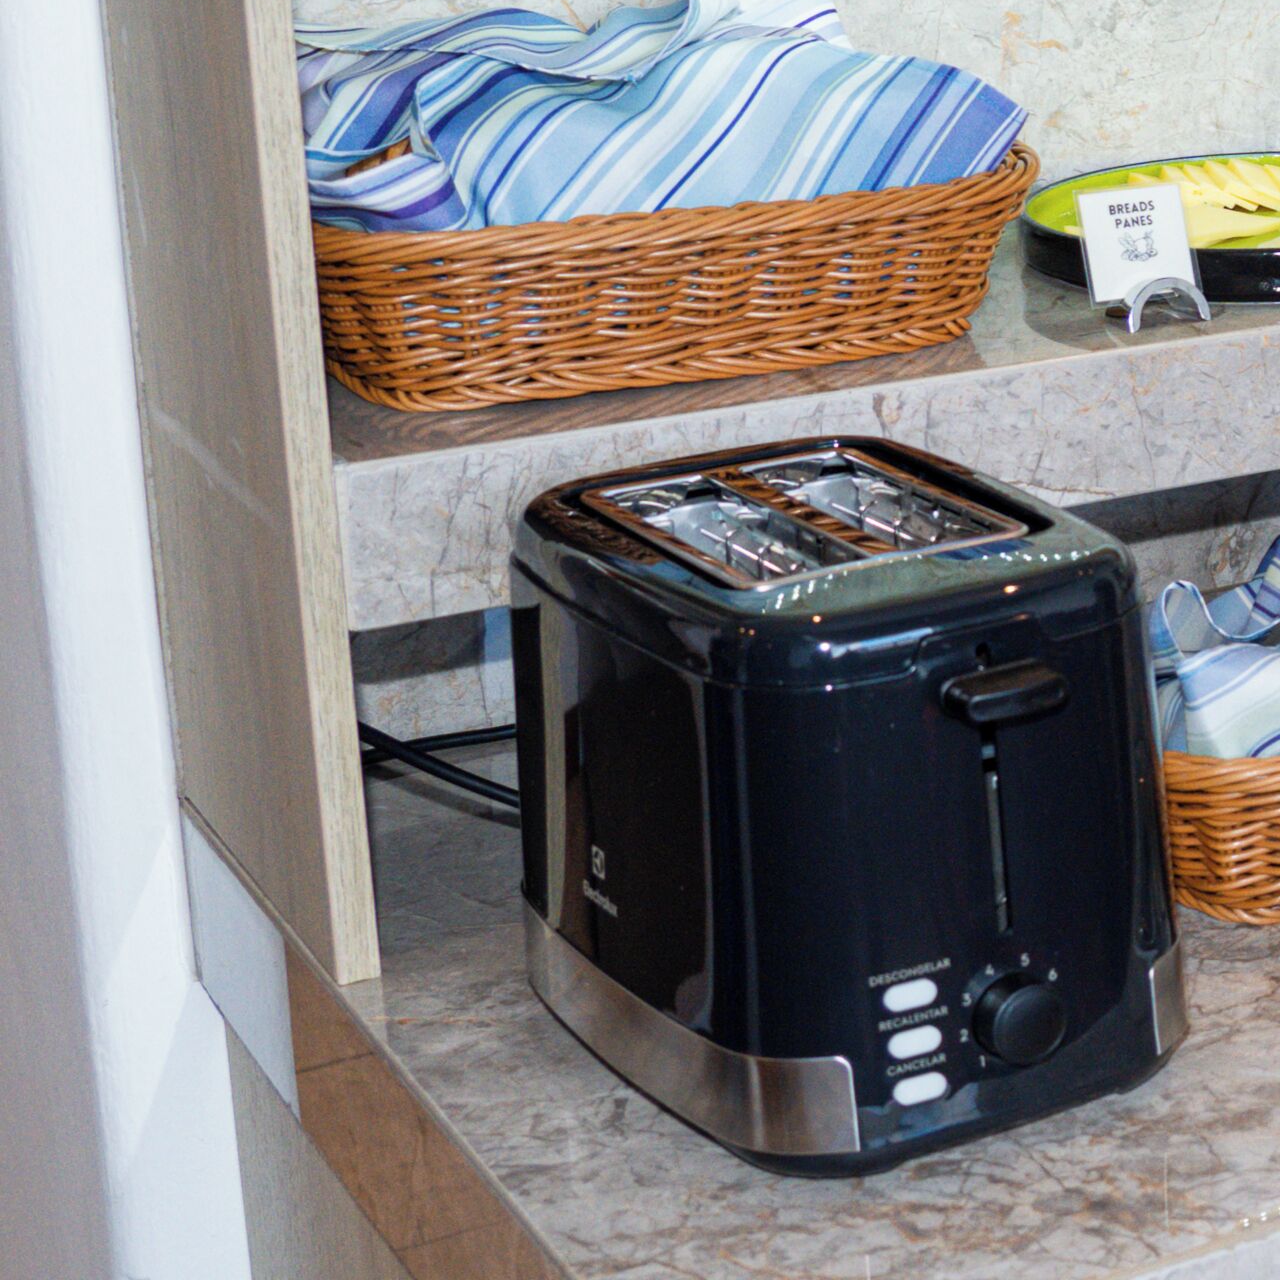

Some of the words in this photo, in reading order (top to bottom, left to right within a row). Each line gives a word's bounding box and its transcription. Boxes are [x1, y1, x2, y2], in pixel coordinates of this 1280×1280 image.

[1109, 200, 1155, 215] BREADS
[1115, 215, 1153, 229] PANES
[1020, 952, 1031, 967] 5
[868, 957, 951, 988] DESCONGELAR
[984, 964, 995, 976] 4
[1047, 968, 1058, 982] 6
[961, 992, 972, 1007] 3
[878, 1005, 949, 1032] RECALENTAR
[959, 1028, 969, 1043] 2
[886, 1053, 946, 1077] CANCELAR
[978, 1055, 987, 1068] 1
